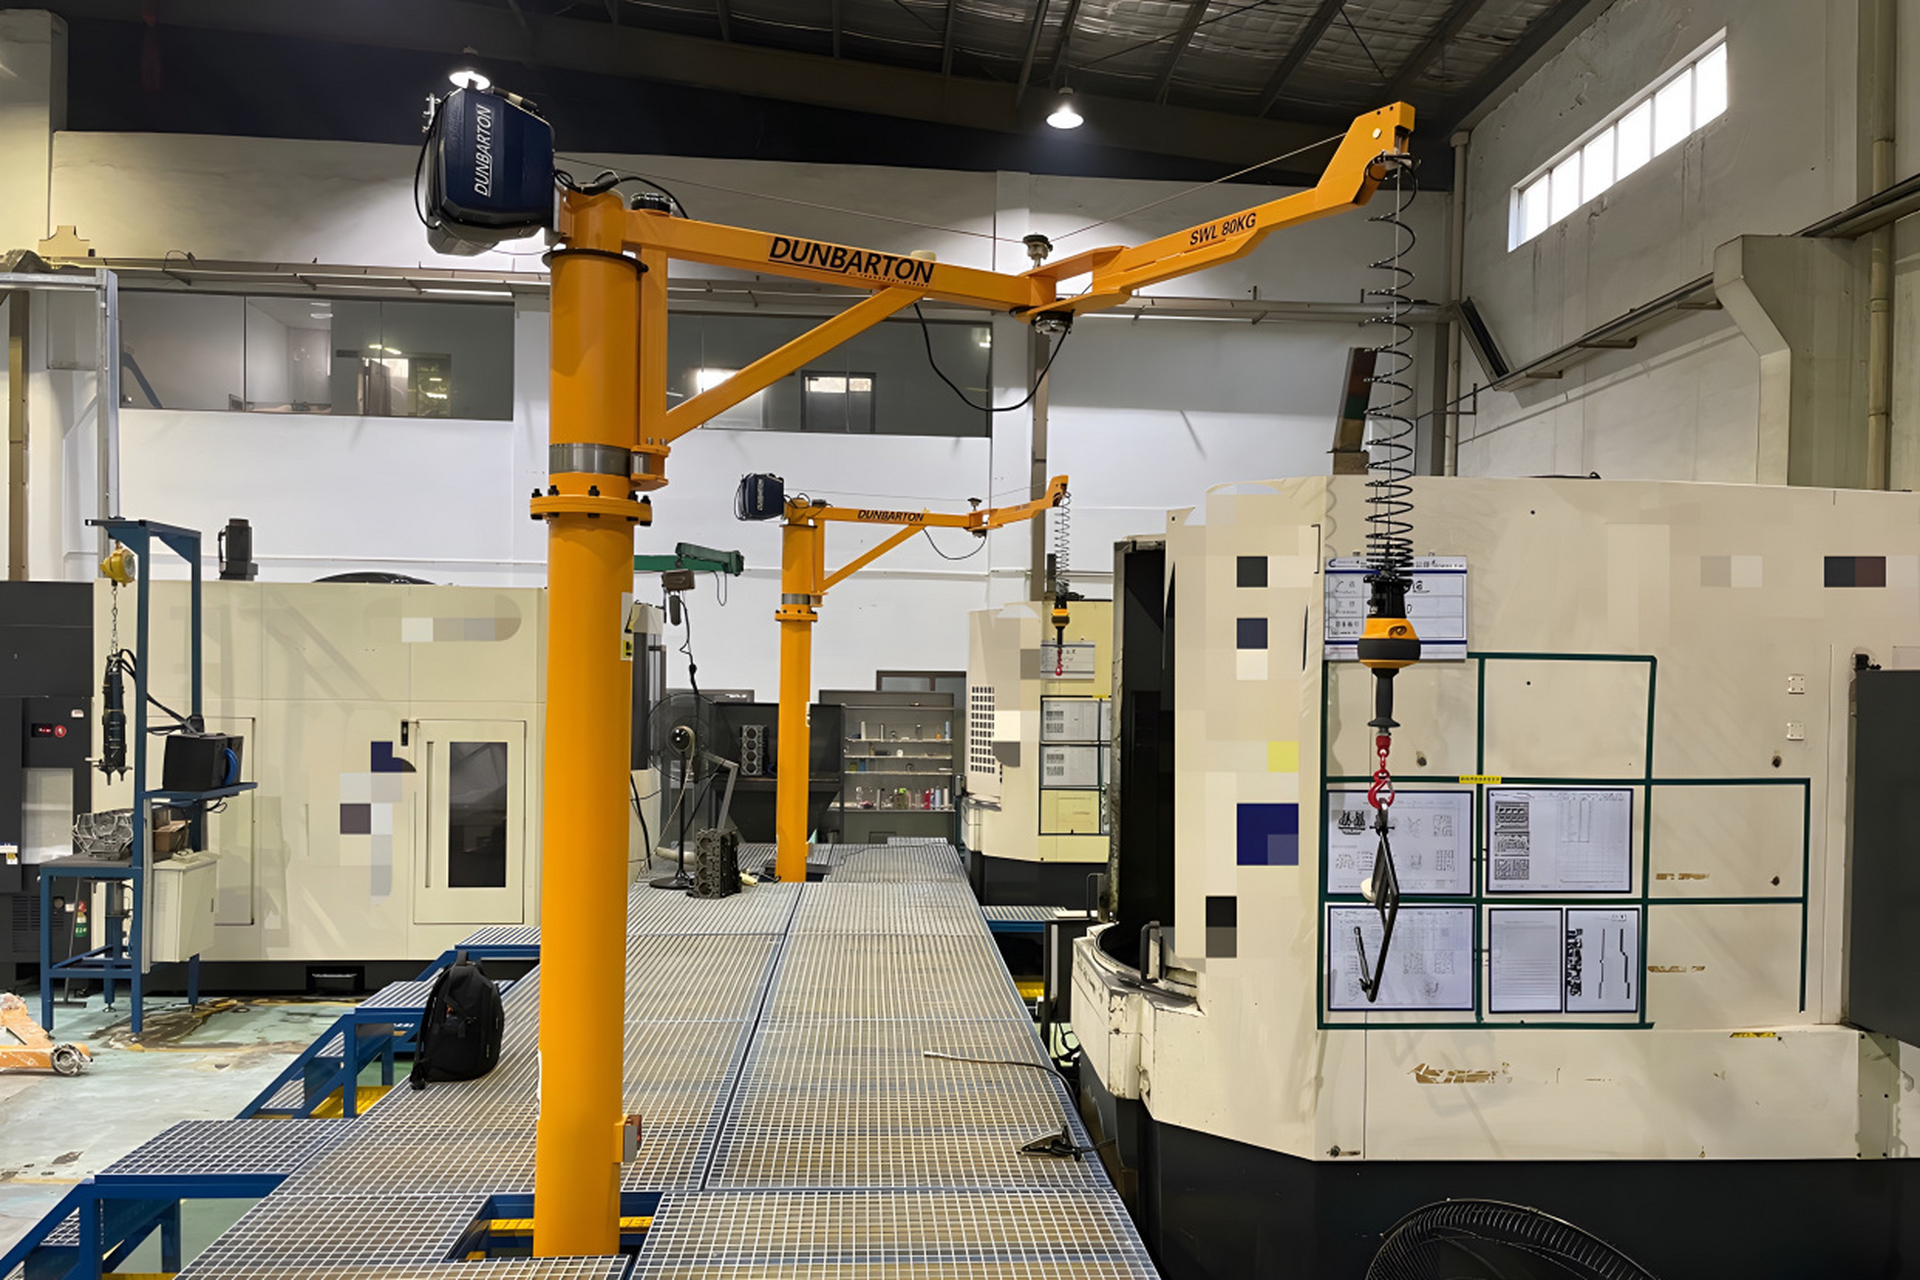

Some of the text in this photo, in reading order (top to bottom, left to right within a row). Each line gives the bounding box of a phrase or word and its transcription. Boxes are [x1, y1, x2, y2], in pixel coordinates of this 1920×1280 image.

[474, 103, 492, 198] DUNBARTON
[1190, 212, 1257, 246] SWL 80KG
[768, 236, 935, 284] DUNBARTON
[857, 509, 924, 522] DUNBARTON
